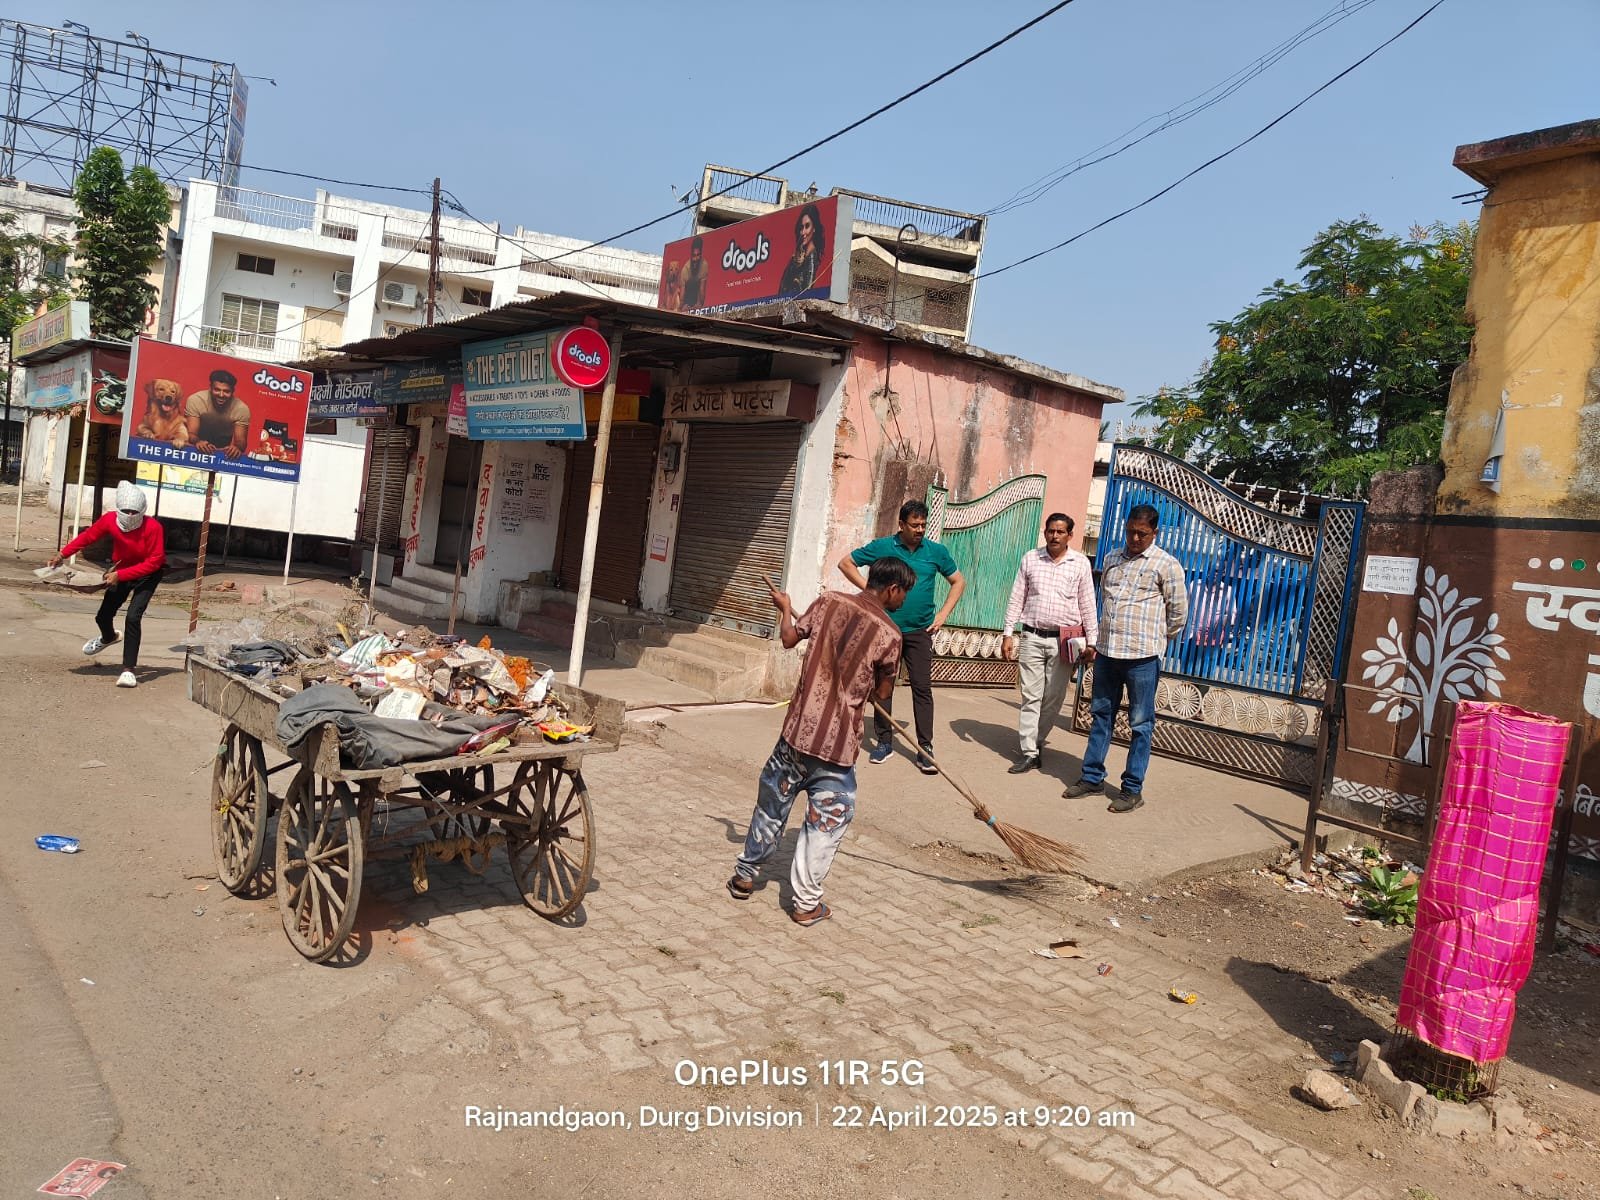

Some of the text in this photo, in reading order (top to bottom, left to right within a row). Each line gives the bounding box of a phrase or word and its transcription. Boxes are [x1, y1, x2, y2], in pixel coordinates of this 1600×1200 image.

[721, 233, 770, 272] drools
[476, 354, 495, 385] THE
[498, 351, 516, 383] PET
[520, 347, 545, 382] DIET
[569, 344, 601, 366] drools
[254, 369, 304, 393] drools
[335, 378, 373, 400] मेडिकल
[670, 387, 688, 414] श्री
[137, 444, 216, 464] THE PET DIET
